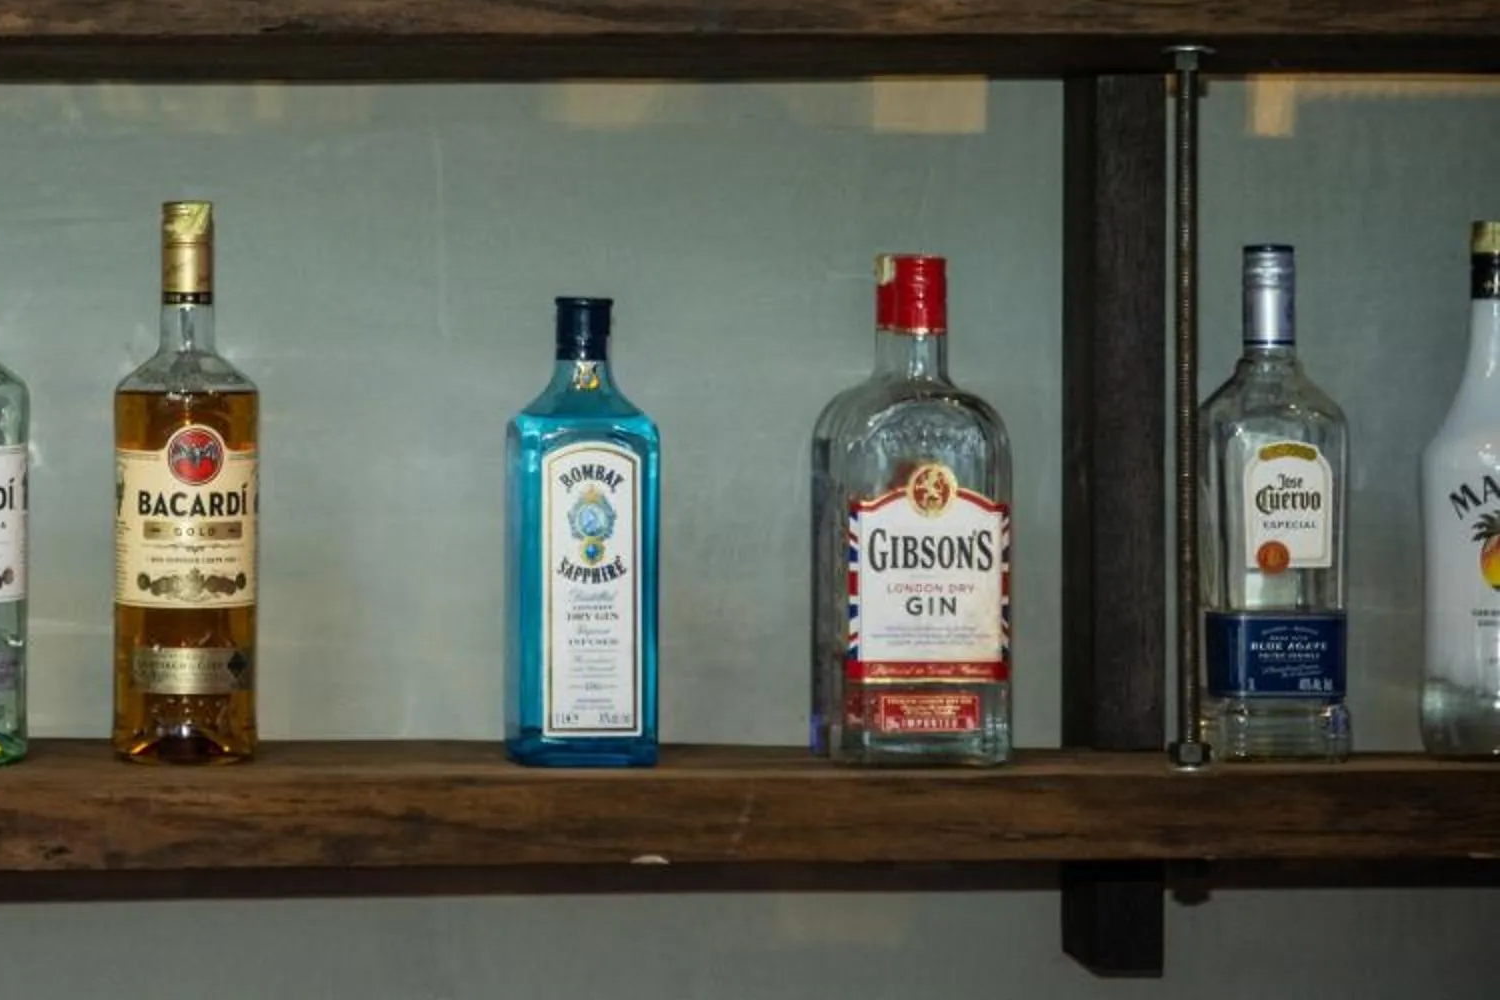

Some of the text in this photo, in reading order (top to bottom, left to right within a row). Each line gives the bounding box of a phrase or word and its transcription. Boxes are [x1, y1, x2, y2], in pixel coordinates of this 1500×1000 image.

[560, 463, 626, 494] BOMBAY
[138, 483, 248, 517] BACARDÍ
[1255, 486, 1322, 515] Cuervo
[172, 527, 217, 537] GOLD
[1262, 520, 1318, 530] ESPECIAL
[867, 527, 994, 573] GIBSON'S
[557, 555, 628, 586] SAPPHIRE
[887, 583, 975, 595] LONDON DRY
[905, 596, 957, 617] GIN
